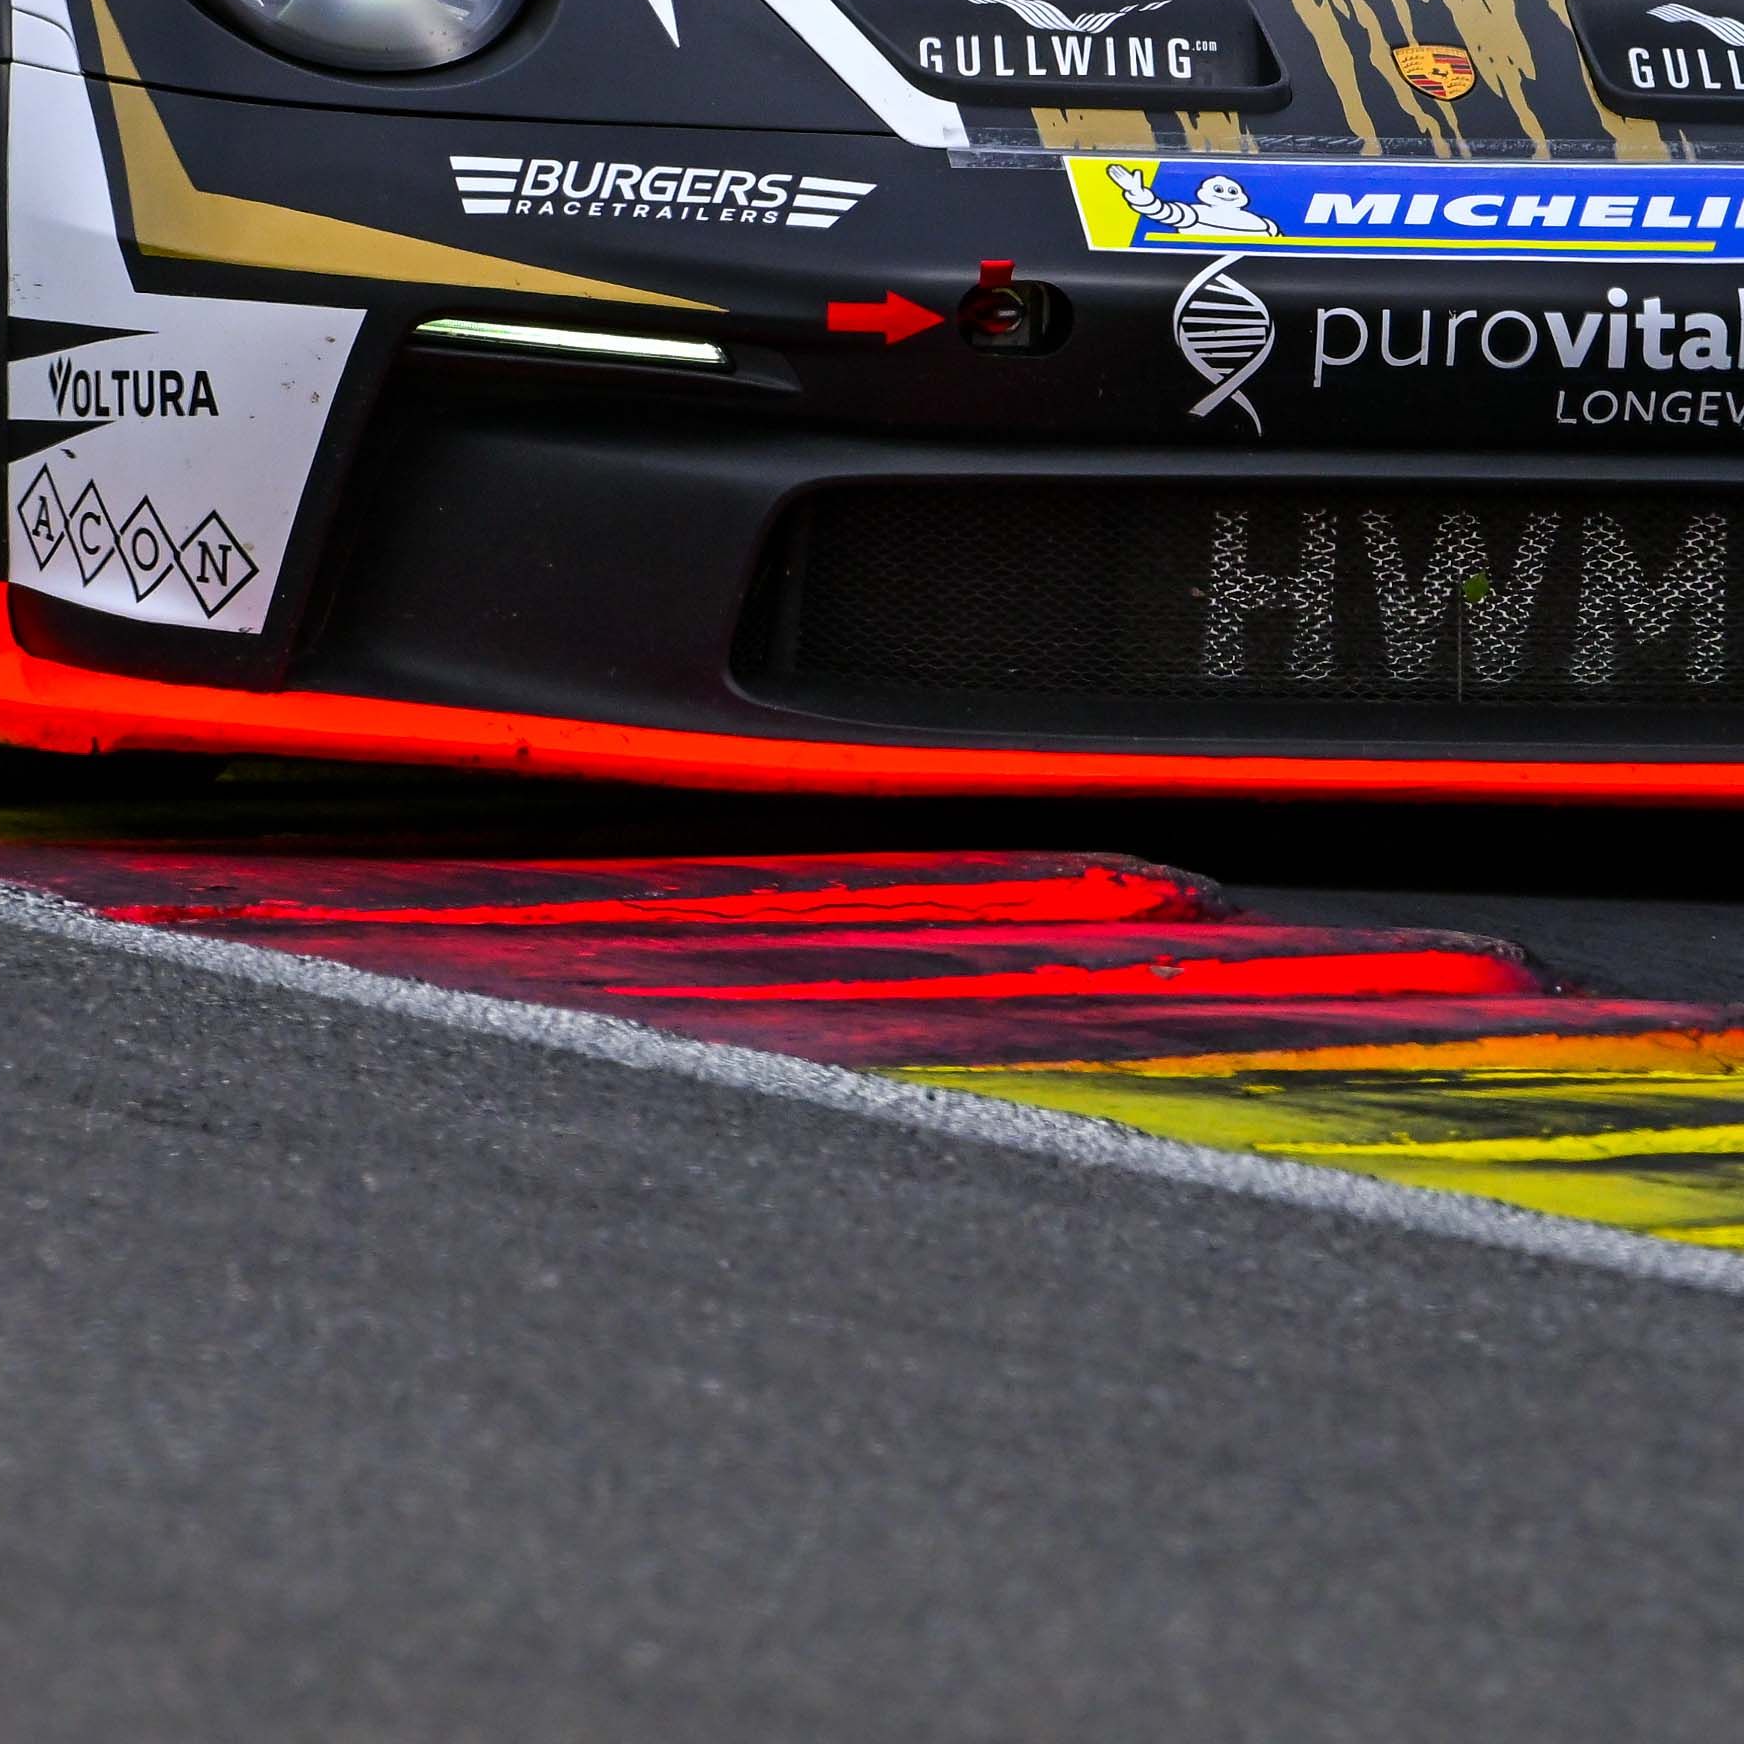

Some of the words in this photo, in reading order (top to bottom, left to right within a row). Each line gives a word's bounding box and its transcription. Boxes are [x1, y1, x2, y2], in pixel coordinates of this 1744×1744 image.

[515, 201, 779, 224] RACETRAILERS
[520, 158, 793, 208] BURGERS
[48, 357, 219, 418] VOLTURA
[28, 491, 238, 592] ACON
[1203, 508, 1728, 684] HWM
